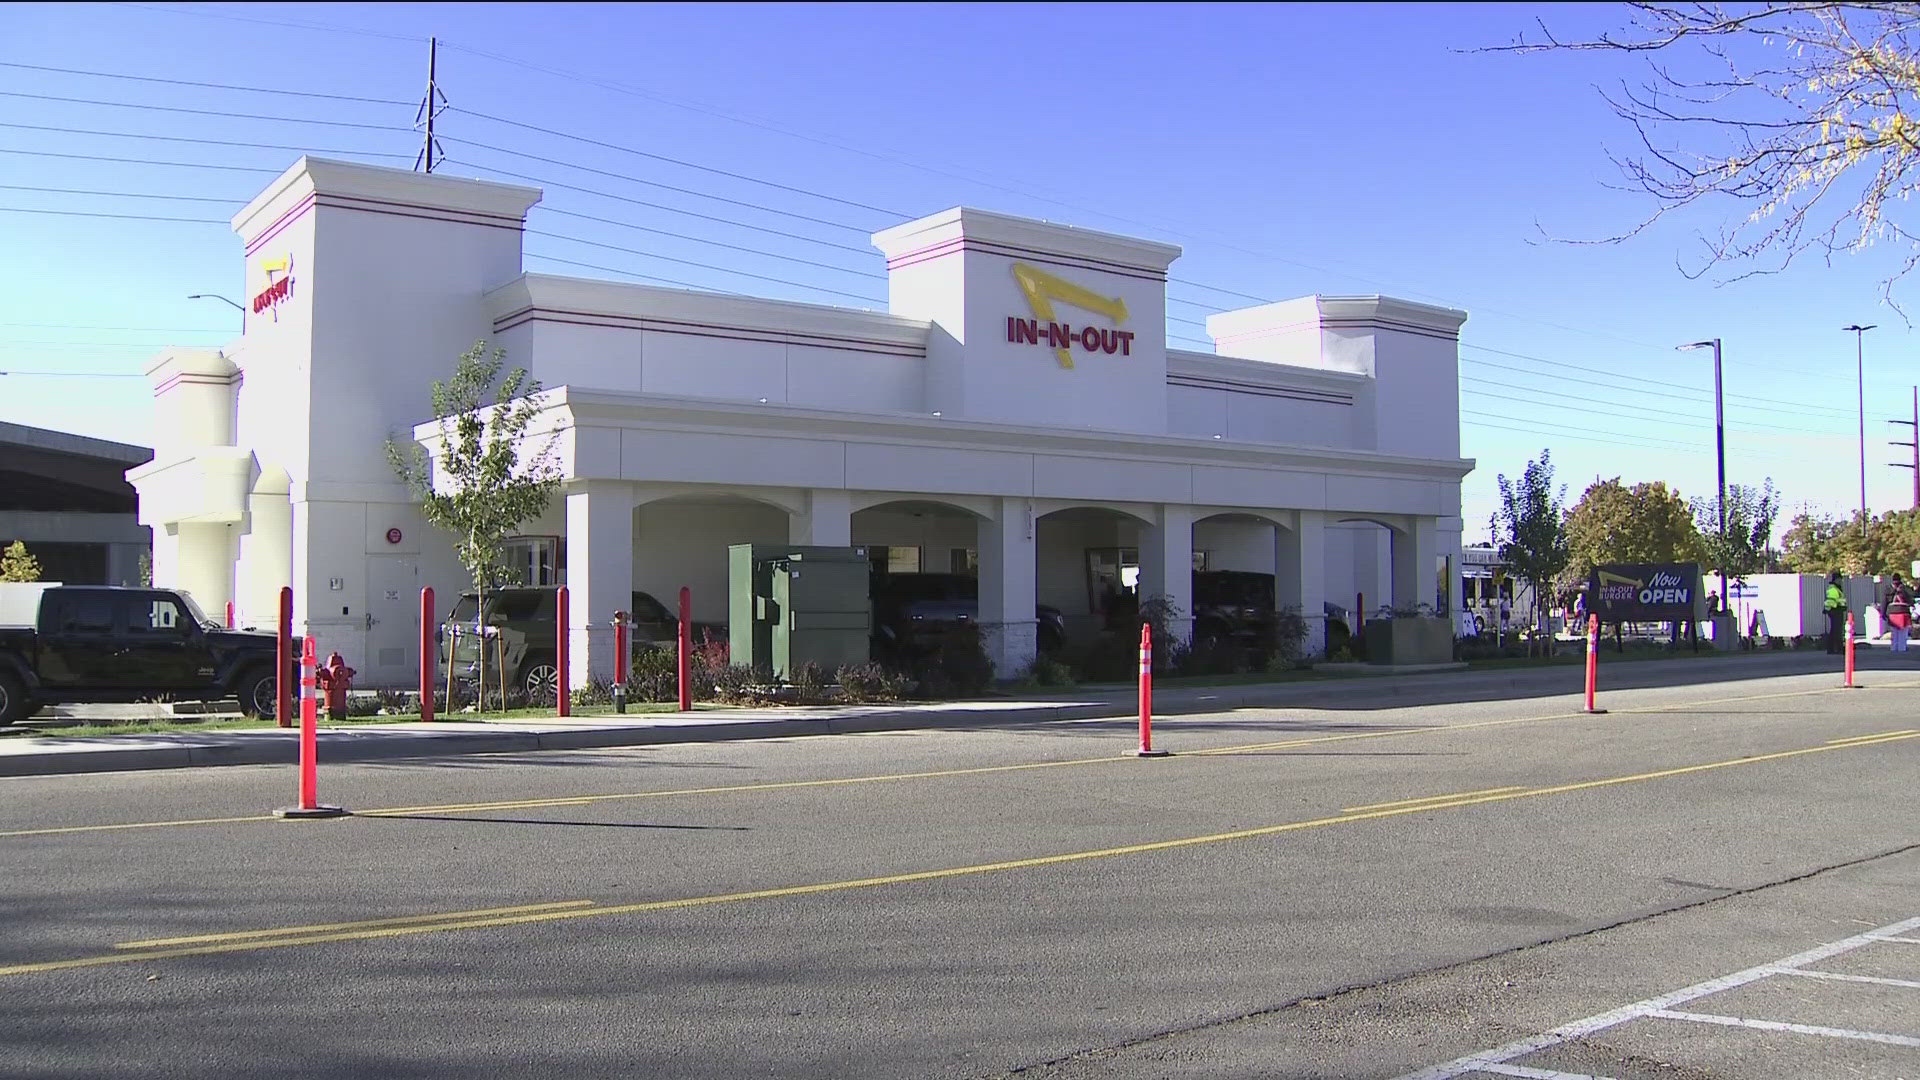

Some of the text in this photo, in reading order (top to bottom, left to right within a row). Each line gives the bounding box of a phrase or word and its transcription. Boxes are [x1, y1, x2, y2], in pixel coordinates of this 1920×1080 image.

[1007, 316, 1135, 356] IN-N-OUT
[1648, 571, 1681, 587] Now
[1599, 592, 1633, 600] BURGER
[1639, 588, 1688, 604] OPEN
